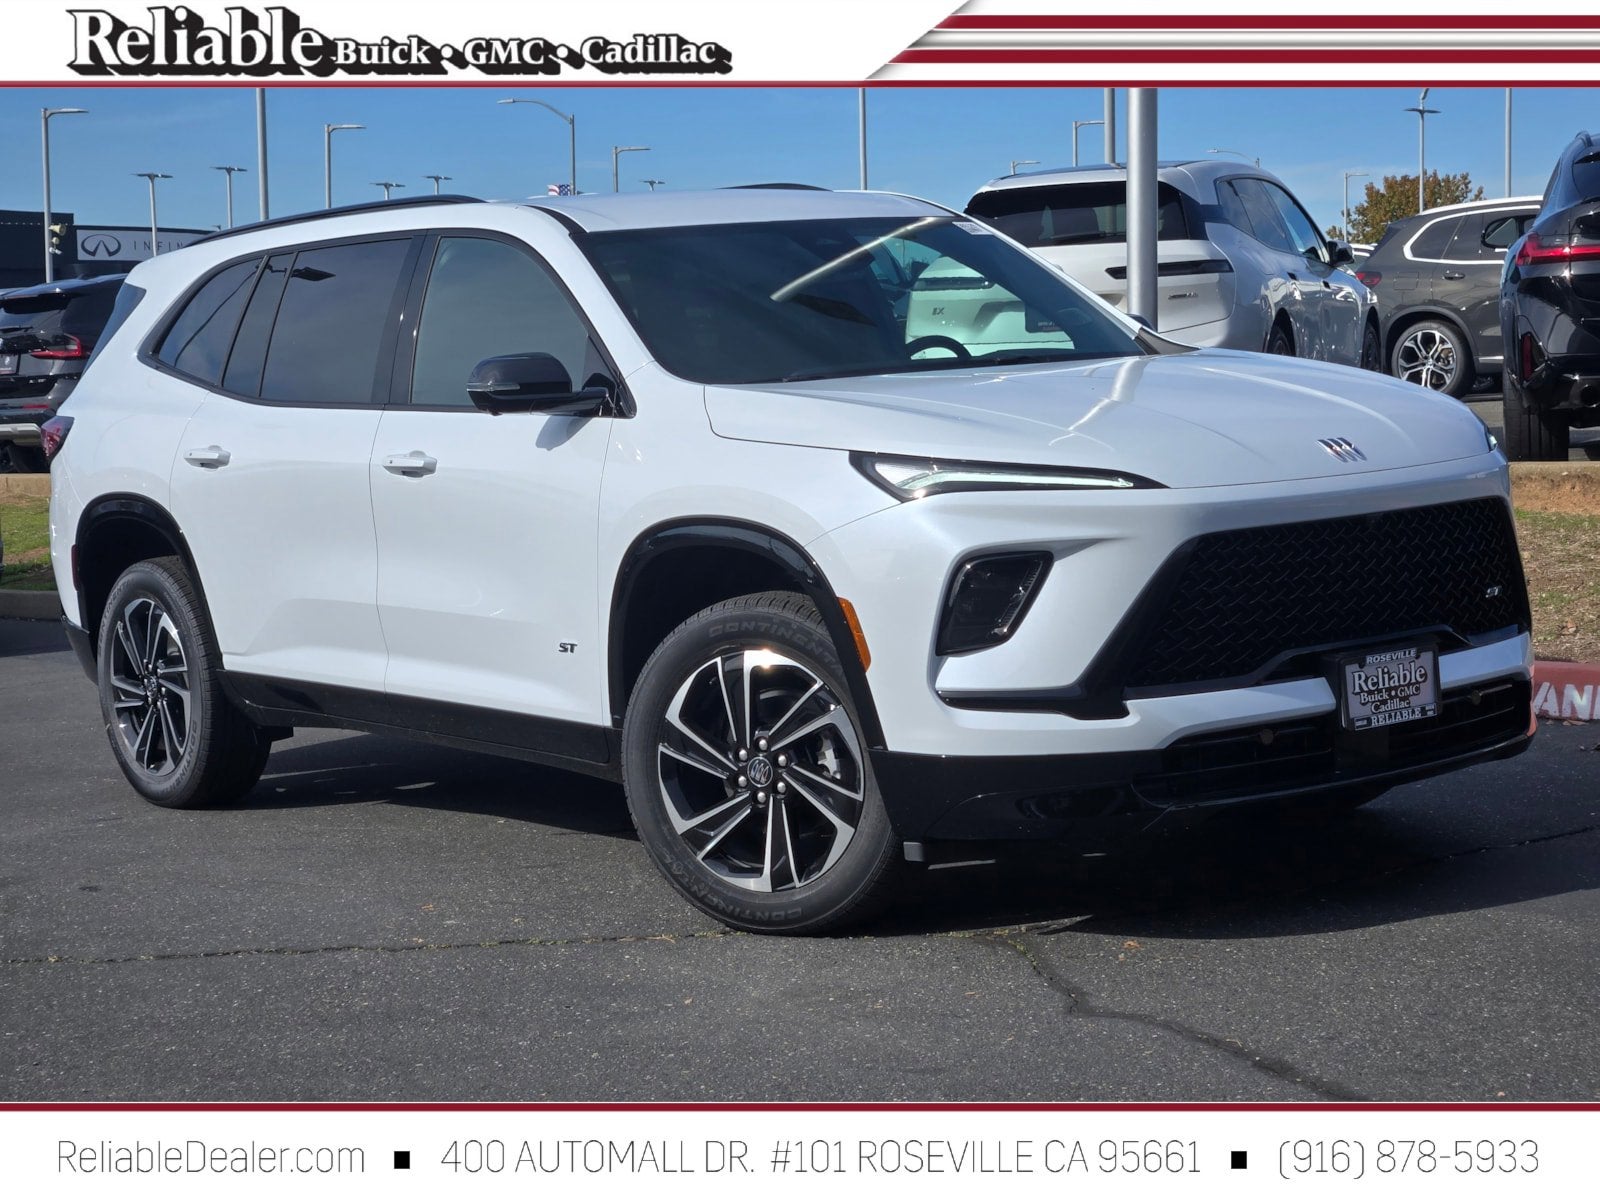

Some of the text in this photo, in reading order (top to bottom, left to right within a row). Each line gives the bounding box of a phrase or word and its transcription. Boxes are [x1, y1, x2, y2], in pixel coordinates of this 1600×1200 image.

[558, 642, 578, 653] ST
[1366, 648, 1417, 664] ROSEVILLE
[1352, 661, 1427, 694] Reliable
[1360, 684, 1420, 704] Buick GMC
[1533, 681, 1600, 720] AN
[1371, 698, 1410, 714] Cadillac
[1371, 708, 1421, 726] RELIABLE
